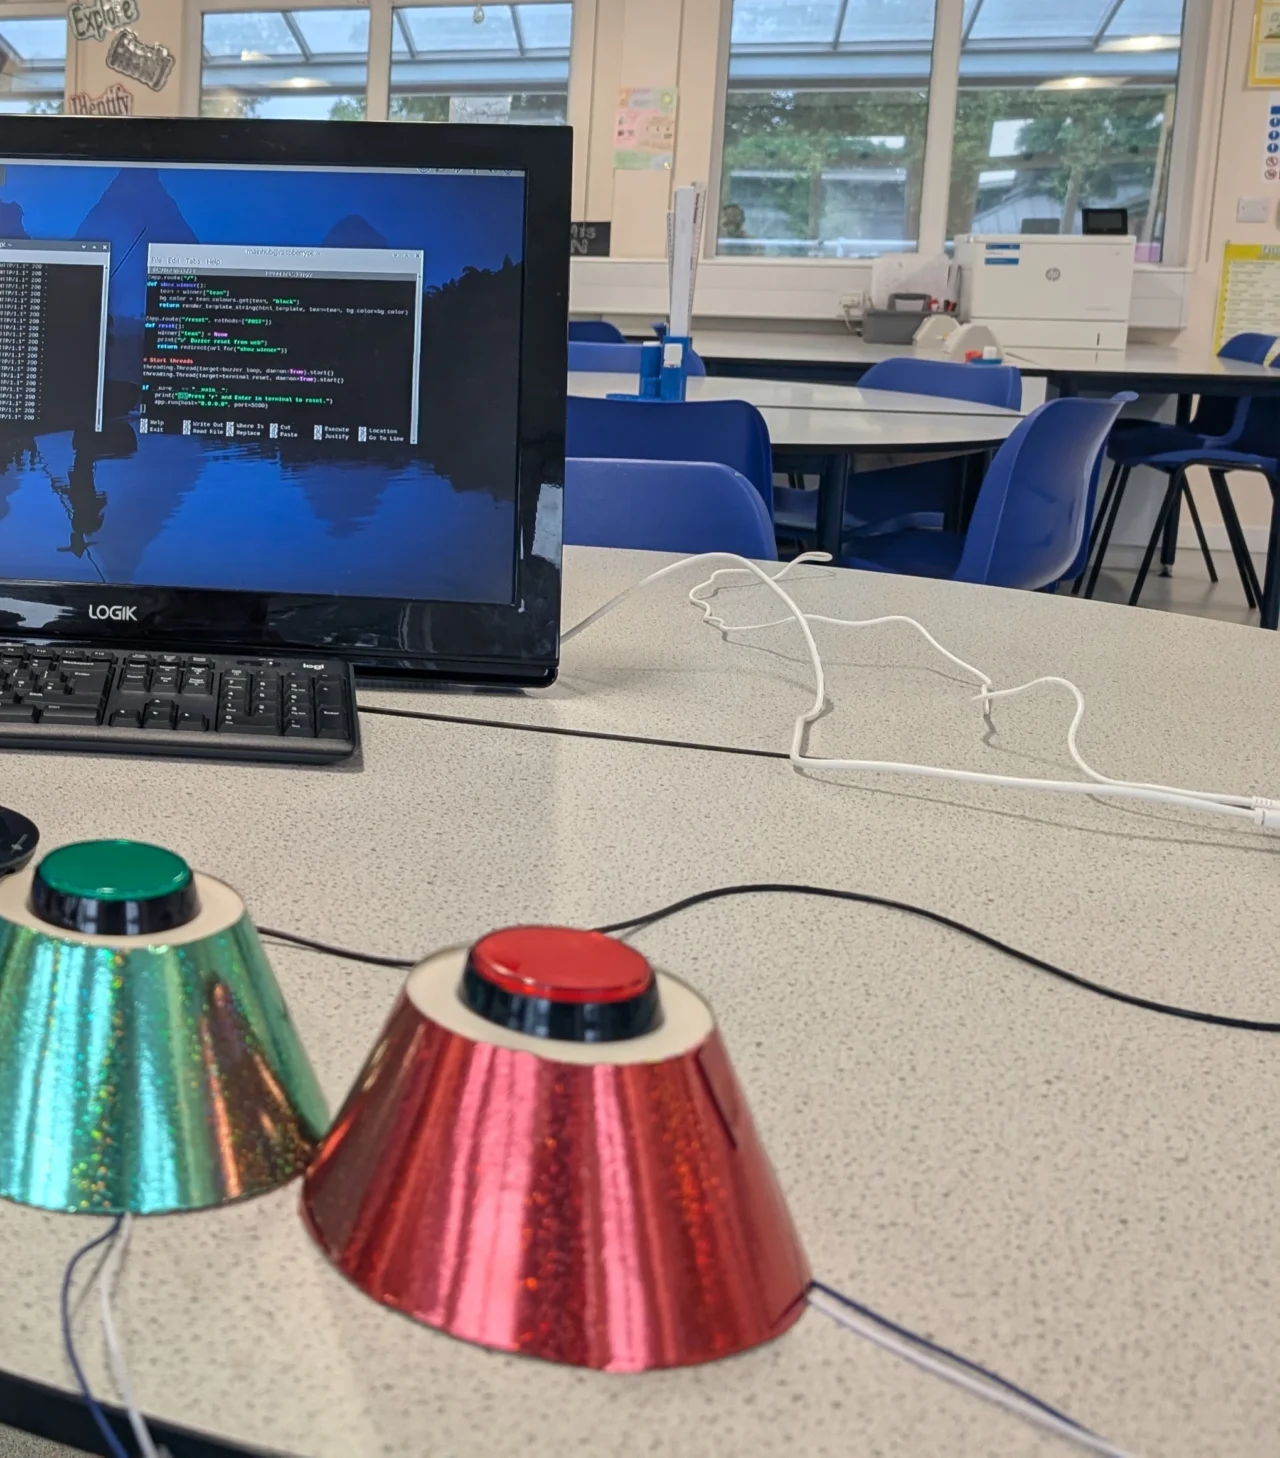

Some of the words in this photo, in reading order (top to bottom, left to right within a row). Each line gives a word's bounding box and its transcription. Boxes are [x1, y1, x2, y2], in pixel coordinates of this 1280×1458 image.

[206, 258, 221, 266] Help
[1045, 268, 1061, 281] hp
[88, 604, 138, 621] LOGIK
[302, 662, 325, 671] logi
